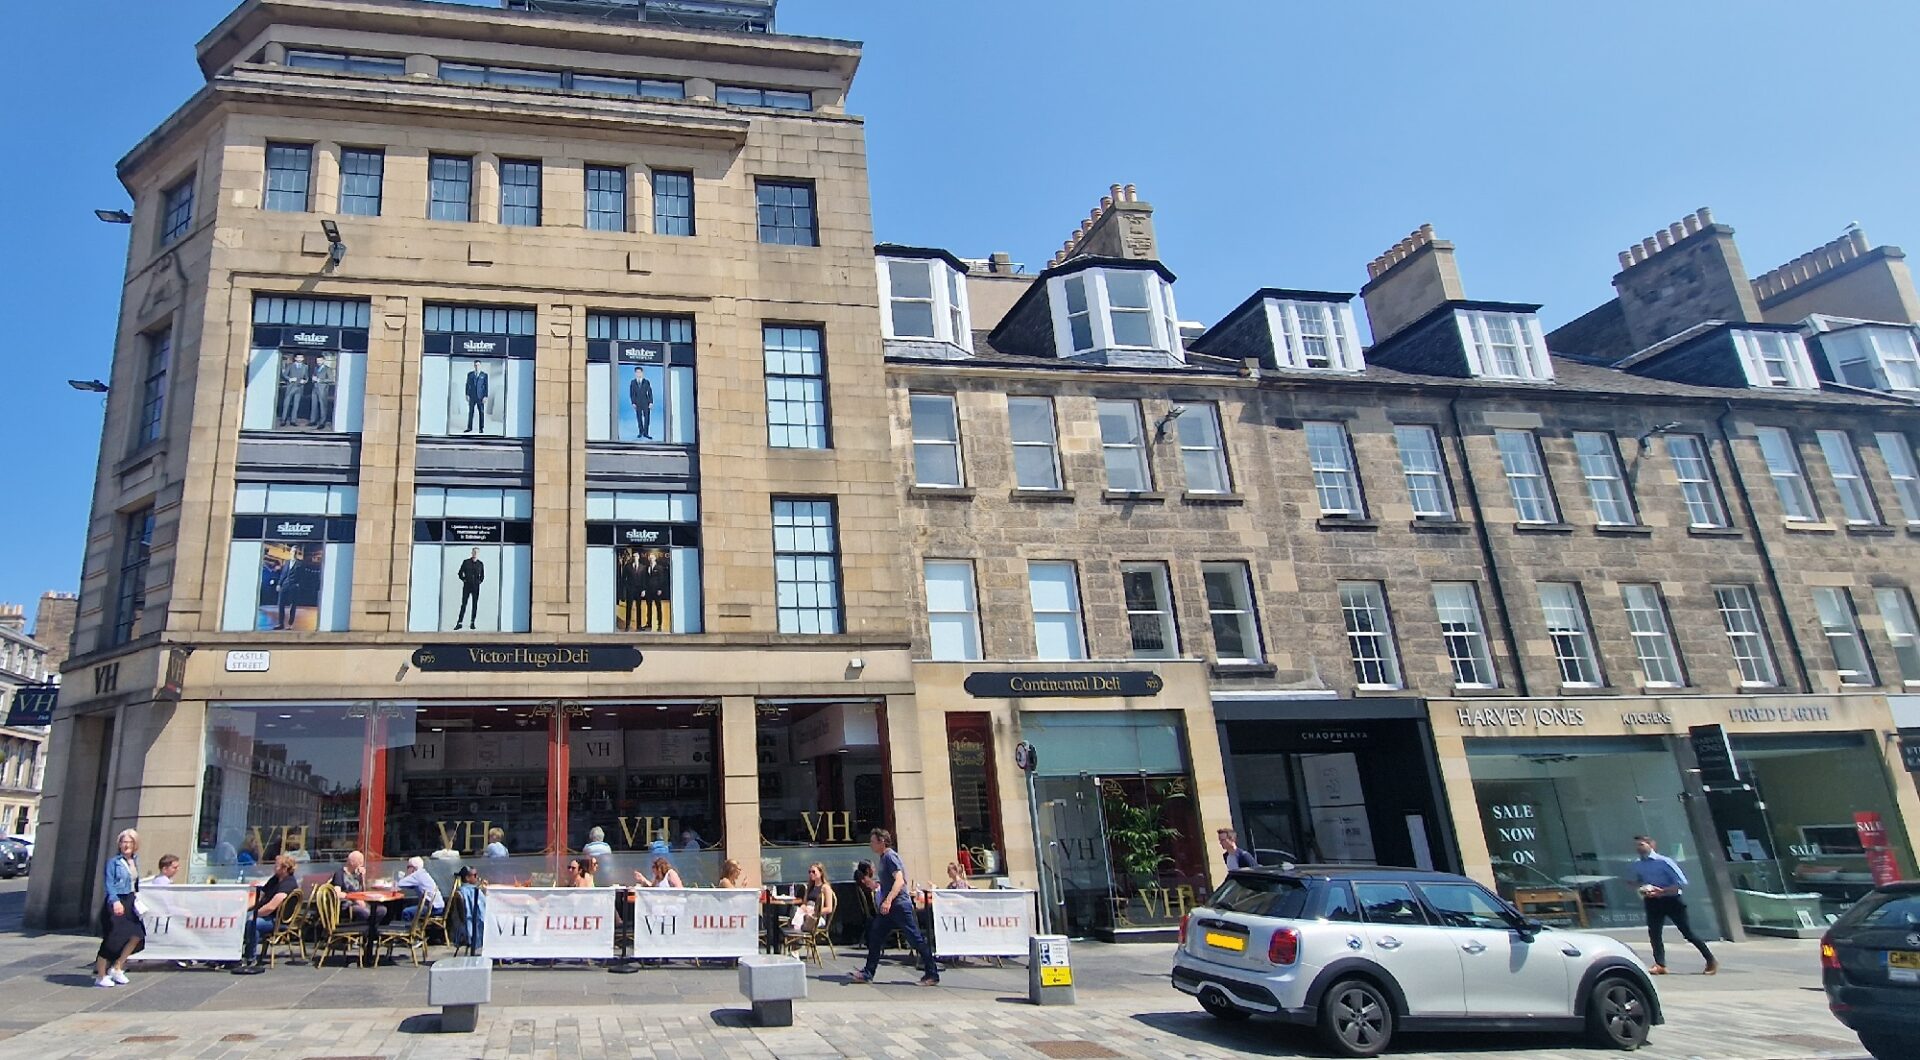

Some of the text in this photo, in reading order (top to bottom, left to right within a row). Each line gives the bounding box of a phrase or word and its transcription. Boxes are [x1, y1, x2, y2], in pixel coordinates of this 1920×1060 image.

[293, 332, 329, 343] slater
[463, 339, 497, 350] slater
[625, 347, 657, 357] slater
[276, 521, 314, 533] slater
[626, 529, 660, 539] slater
[232, 652, 265, 660] CASTLE
[467, 647, 589, 668] Victor Hugo Deli
[93, 661, 120, 695] VH
[1010, 675, 1122, 691] Continental Deli
[19, 693, 57, 713] VH
[1457, 707, 1585, 728] HARVEY JONES
[1620, 712, 1672, 725] KITCHENS
[1728, 706, 1831, 723] FIRED EARTH
[1301, 731, 1368, 740] CHAOPHRAYA
[409, 744, 435, 759] VH
[586, 741, 611, 757] VH
[1492, 804, 1534, 819] SALE
[618, 816, 671, 848] VH
[800, 811, 853, 842] VH
[1499, 827, 1537, 842] NOW
[1857, 821, 1884, 832] SALE
[436, 820, 493, 852] VH
[251, 825, 310, 864] VH
[1060, 838, 1096, 860] VH
[1788, 843, 1820, 856] SALE
[1512, 850, 1536, 865] ON
[1137, 886, 1189, 918] VH
[185, 915, 237, 929] LILLET
[495, 915, 603, 937] VH LILLET
[643, 914, 748, 936] VH LILLET
[940, 916, 1020, 933] VH LILLET
